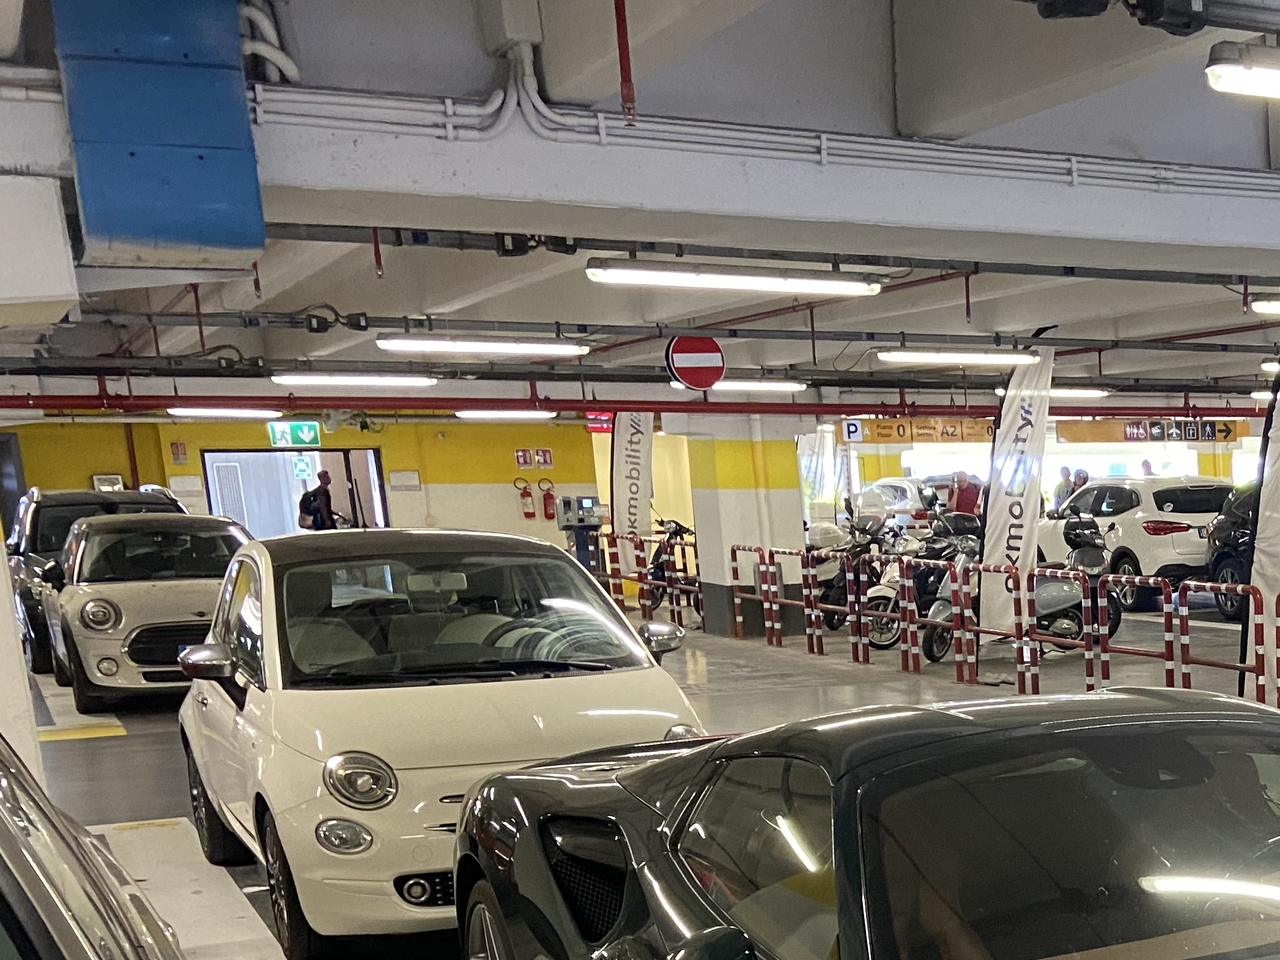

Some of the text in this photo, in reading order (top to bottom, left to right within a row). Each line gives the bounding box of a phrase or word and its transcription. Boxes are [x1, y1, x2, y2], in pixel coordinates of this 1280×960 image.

[847, 422, 858, 439] P
[897, 424, 906, 438] 0
[941, 425, 958, 437] A2
